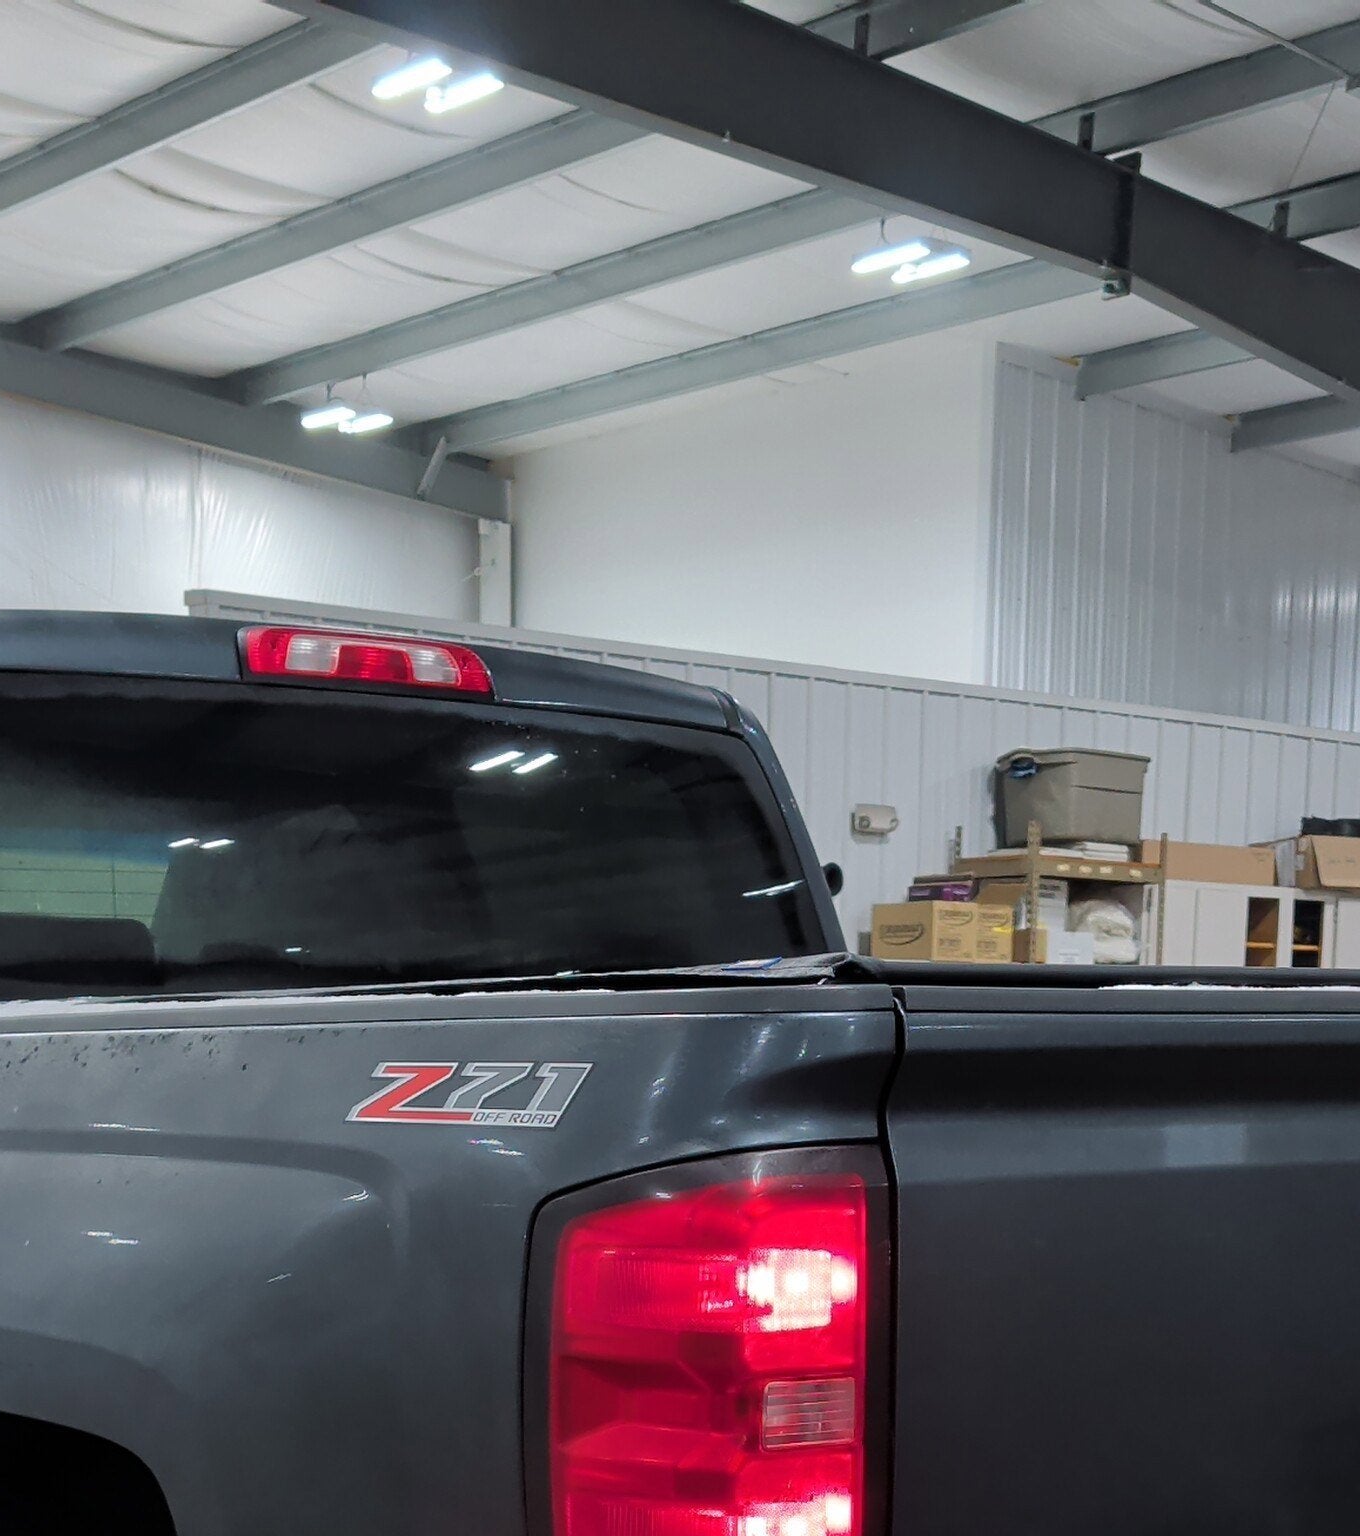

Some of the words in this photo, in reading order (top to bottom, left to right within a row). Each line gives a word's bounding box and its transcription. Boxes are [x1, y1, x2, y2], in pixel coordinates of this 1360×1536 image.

[344, 1061, 594, 1127] Z71
[473, 1111, 507, 1123] OFF
[508, 1112, 558, 1125] ROAD
